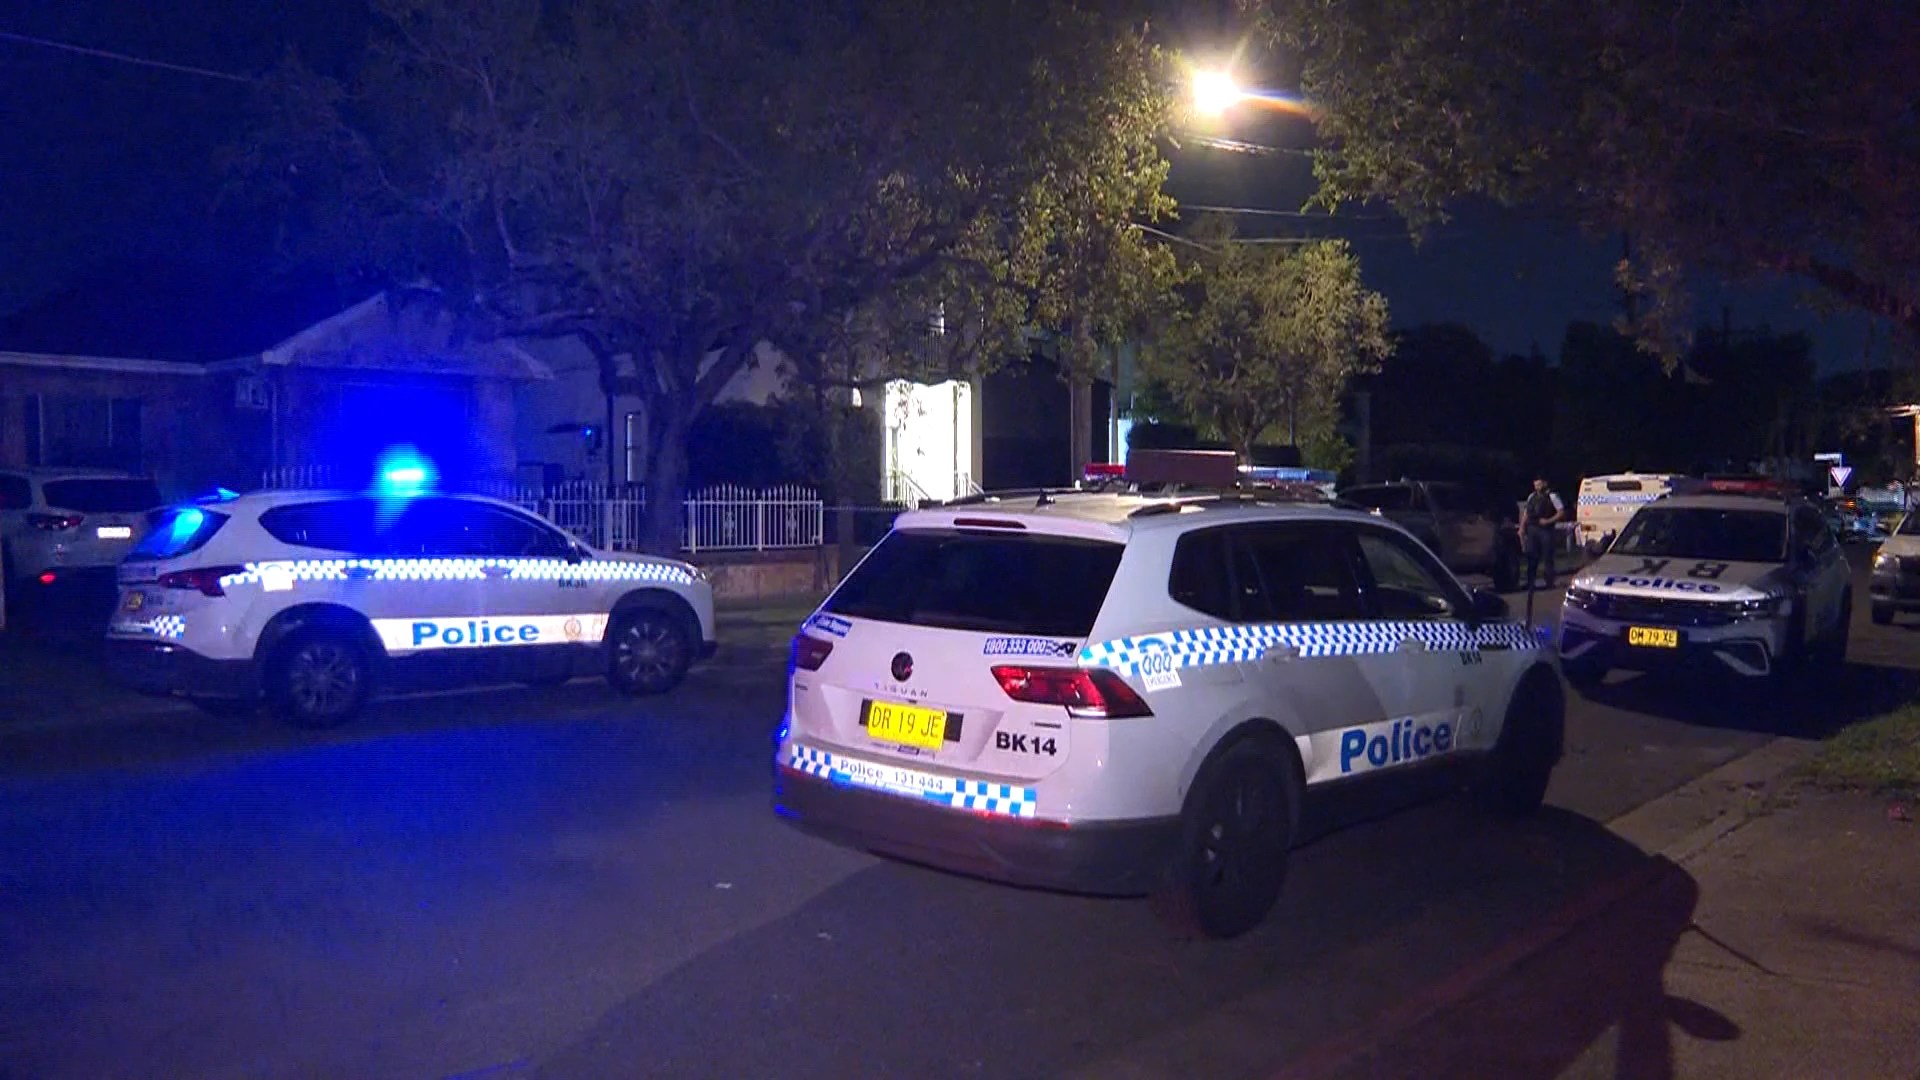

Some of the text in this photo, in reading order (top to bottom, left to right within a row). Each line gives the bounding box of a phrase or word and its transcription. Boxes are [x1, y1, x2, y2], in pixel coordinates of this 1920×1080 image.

[1604, 576, 1721, 593] Police
[412, 620, 540, 646] Police
[1007, 639, 1027, 653] 333
[1027, 639, 1047, 654] 000
[1142, 652, 1173, 676] 000
[874, 682, 929, 698] TIGUAN
[871, 705, 942, 738] DR 19 JE
[1340, 719, 1450, 772] Police
[840, 759, 884, 779] Police
